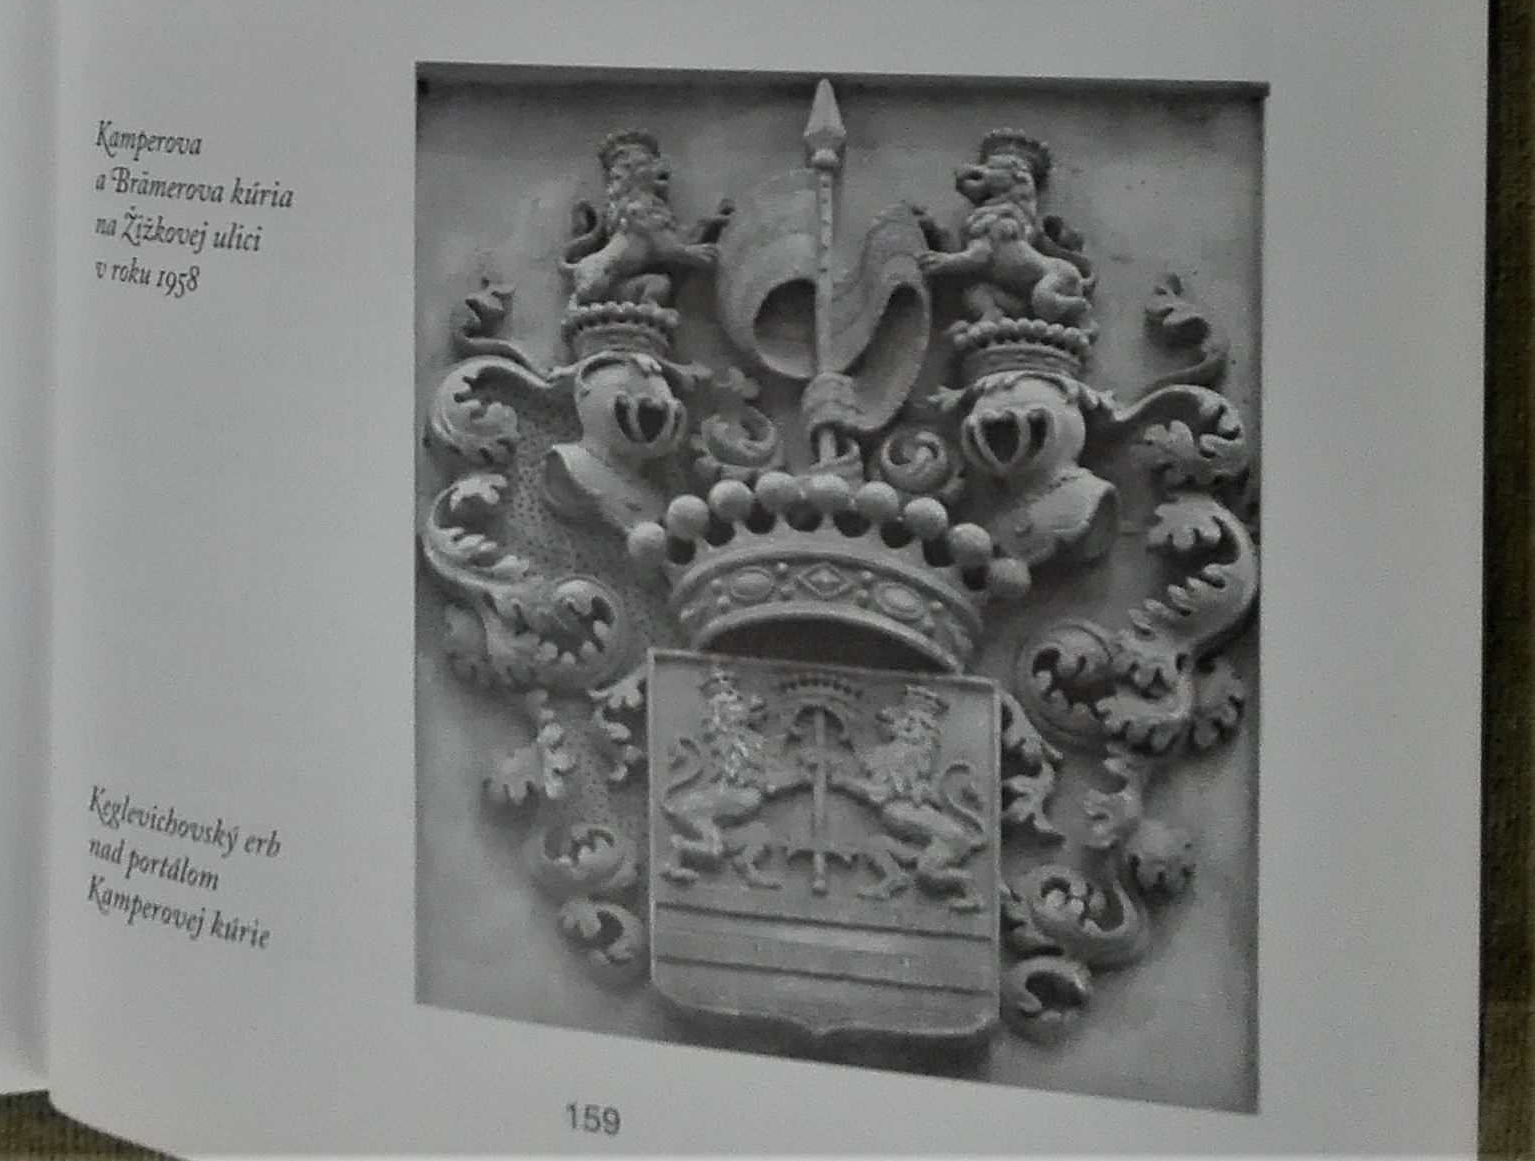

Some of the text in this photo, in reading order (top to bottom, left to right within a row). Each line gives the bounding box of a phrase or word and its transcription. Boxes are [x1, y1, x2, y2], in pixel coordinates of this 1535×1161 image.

[94, 119, 203, 162] Kamperova
[94, 166, 295, 209] a Brämerova kúria
[94, 205, 263, 256] na Žižkovej ulici
[95, 256, 201, 300] v roku 1958
[89, 785, 282, 858] Keglevichovský erb
[88, 838, 220, 892] nad portálom
[87, 873, 271, 950] Kamperovej kúrie
[565, 1101, 622, 1137] 159
